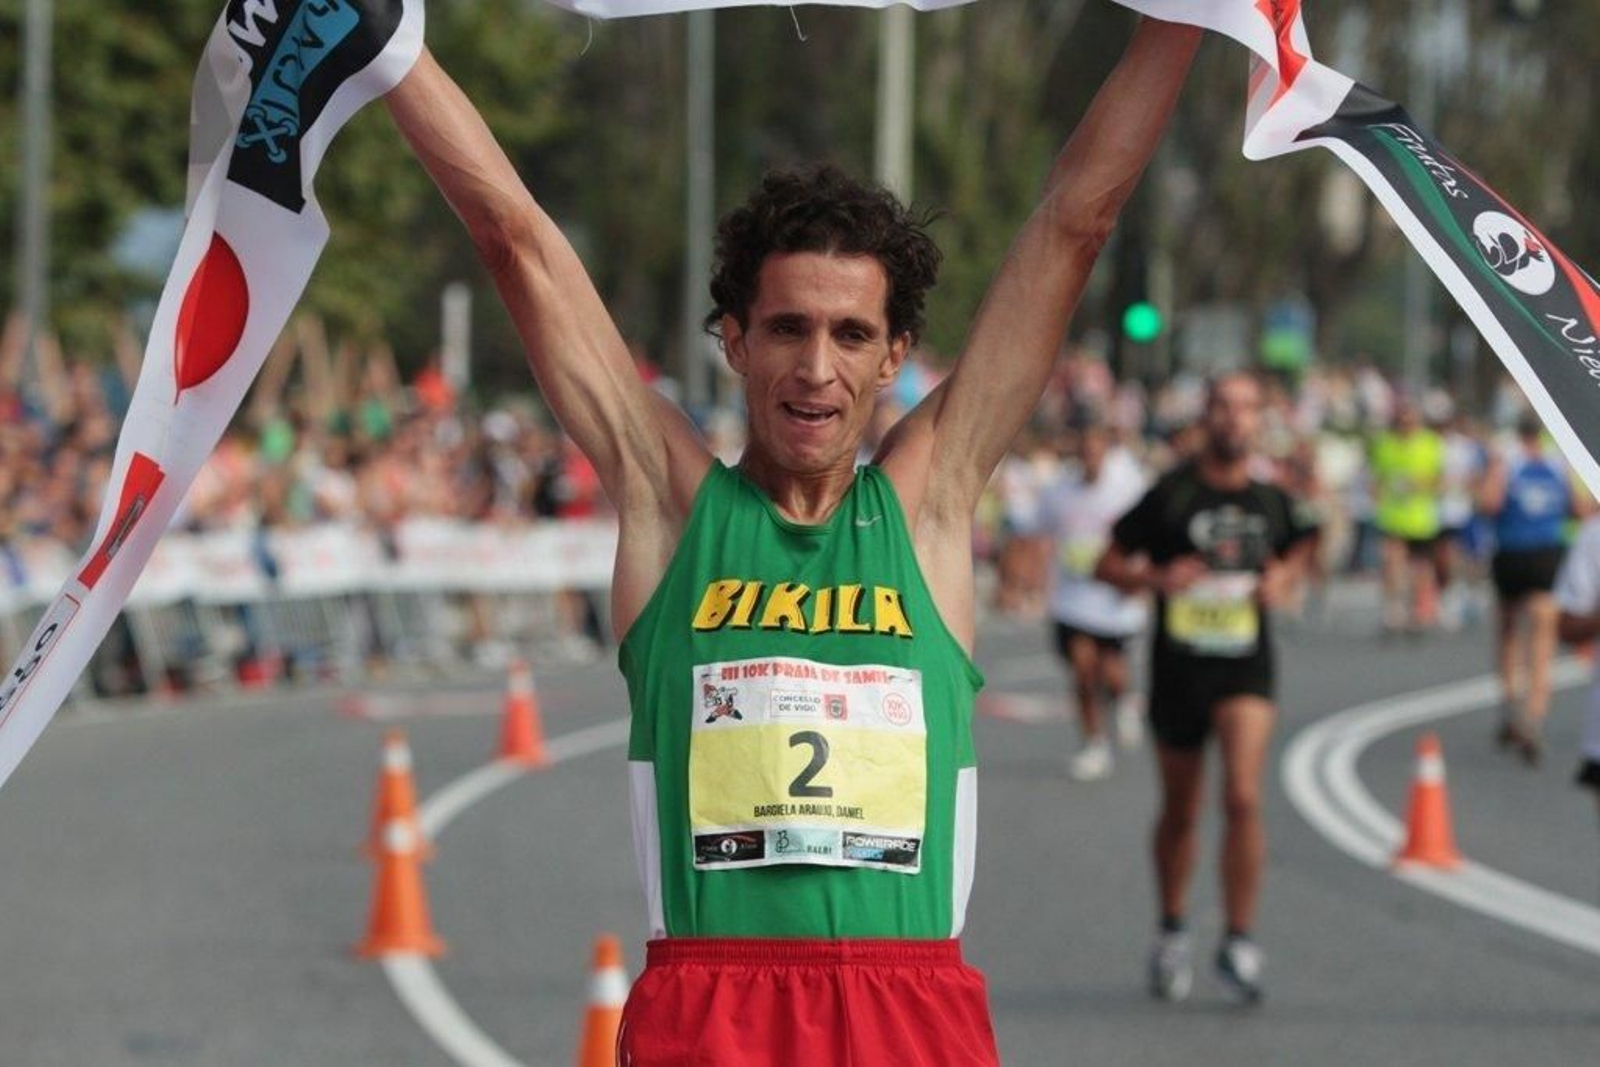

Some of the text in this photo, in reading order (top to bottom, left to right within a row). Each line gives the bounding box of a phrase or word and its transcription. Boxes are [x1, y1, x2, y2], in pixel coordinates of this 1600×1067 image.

[1388, 123, 1469, 198] Frutas
[692, 579, 913, 639] BIKILA
[743, 662, 769, 678] 10K
[773, 662, 817, 680] PRAIA
[822, 668, 839, 682] DE
[779, 703, 816, 712] DE VIGO
[788, 731, 833, 798] 2
[754, 803, 797, 818] BARGIELA
[837, 805, 865, 819] DANIEL
[846, 835, 917, 852] POWERADE
